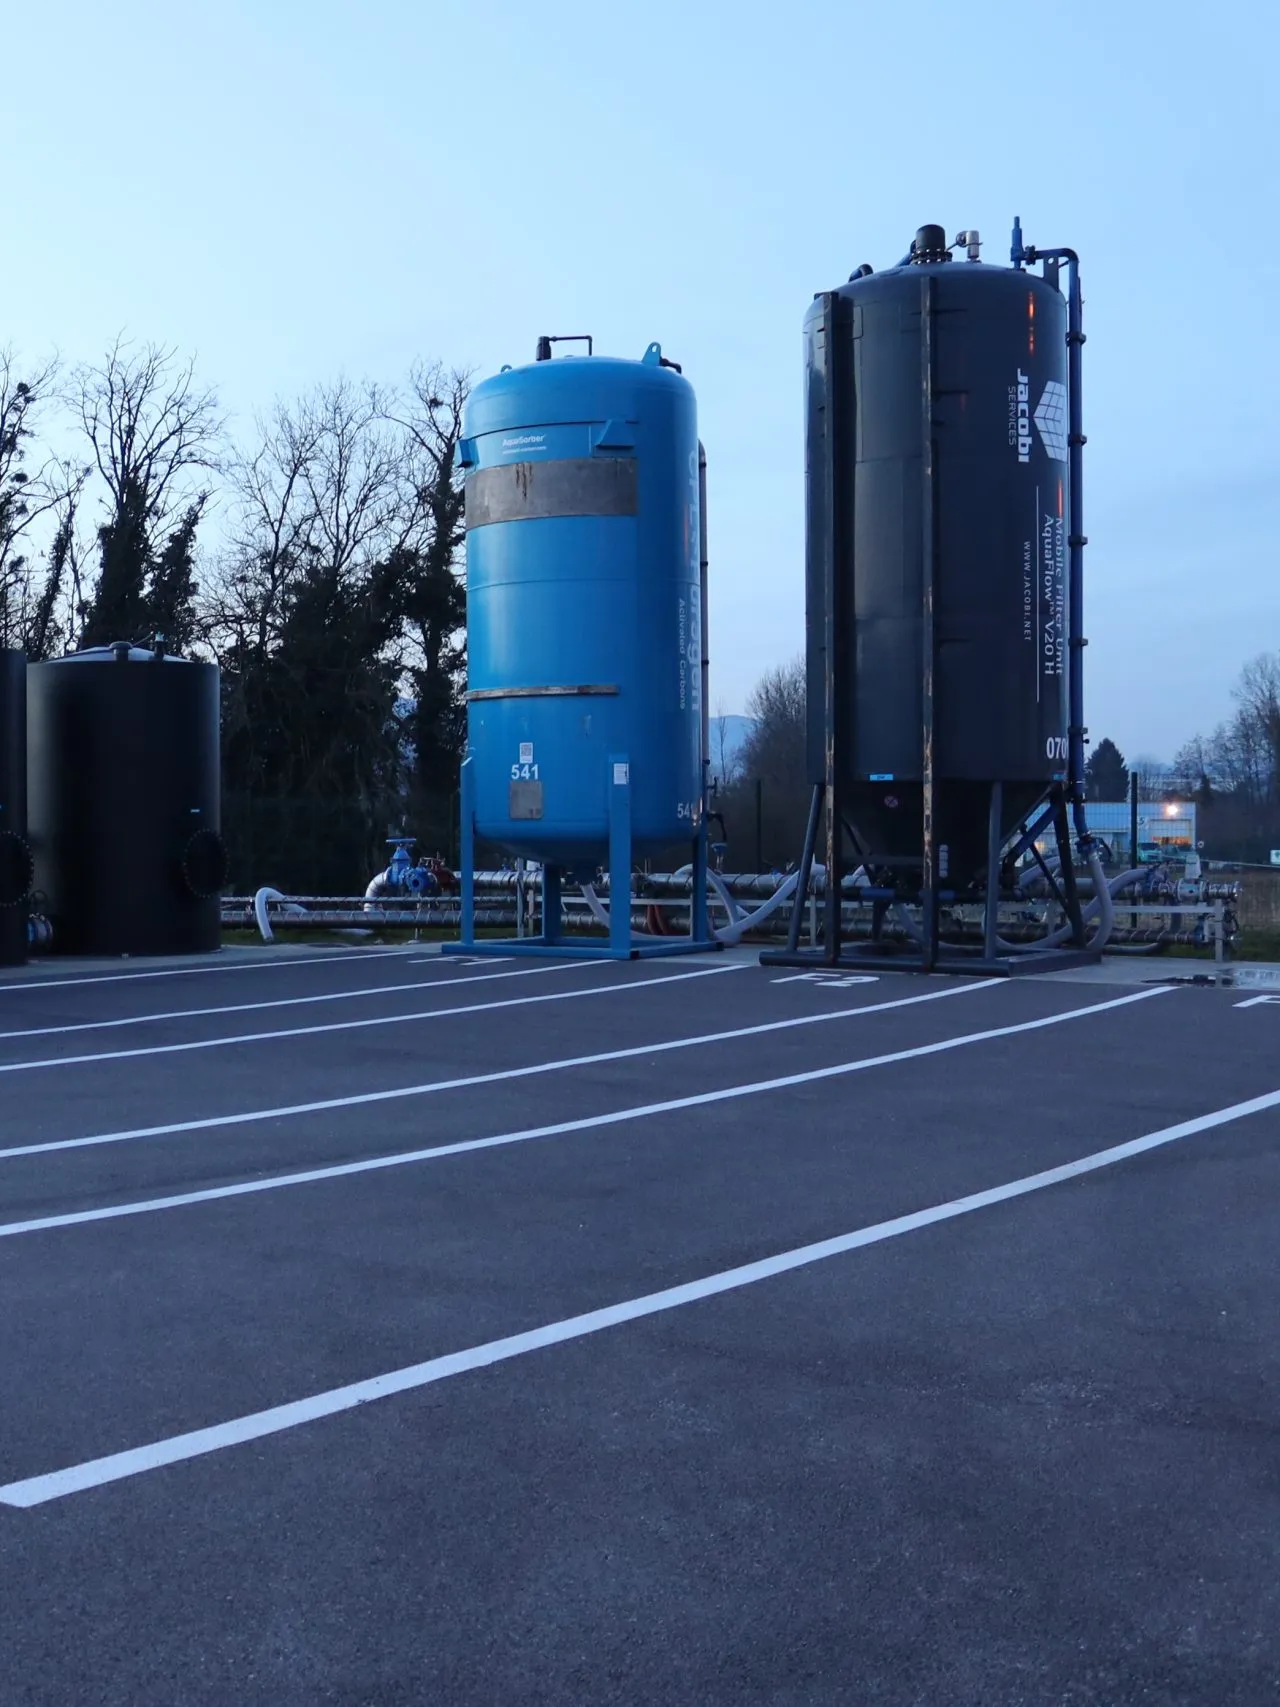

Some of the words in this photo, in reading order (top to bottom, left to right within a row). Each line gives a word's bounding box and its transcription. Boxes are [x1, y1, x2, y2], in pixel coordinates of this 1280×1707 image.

[1007, 385, 1017, 446] SERVICES
[1017, 367, 1032, 463] Jacobi
[1055, 517, 1064, 577] Mobile
[1023, 541, 1032, 641] WWW.JACOBI.NET
[1055, 584, 1064, 631] Filter
[1044, 619, 1055, 656] V20
[1055, 637, 1064, 675] Unit
[1044, 661, 1055, 675] H
[511, 763, 539, 780] 541
[768, 972, 881, 988] F2
